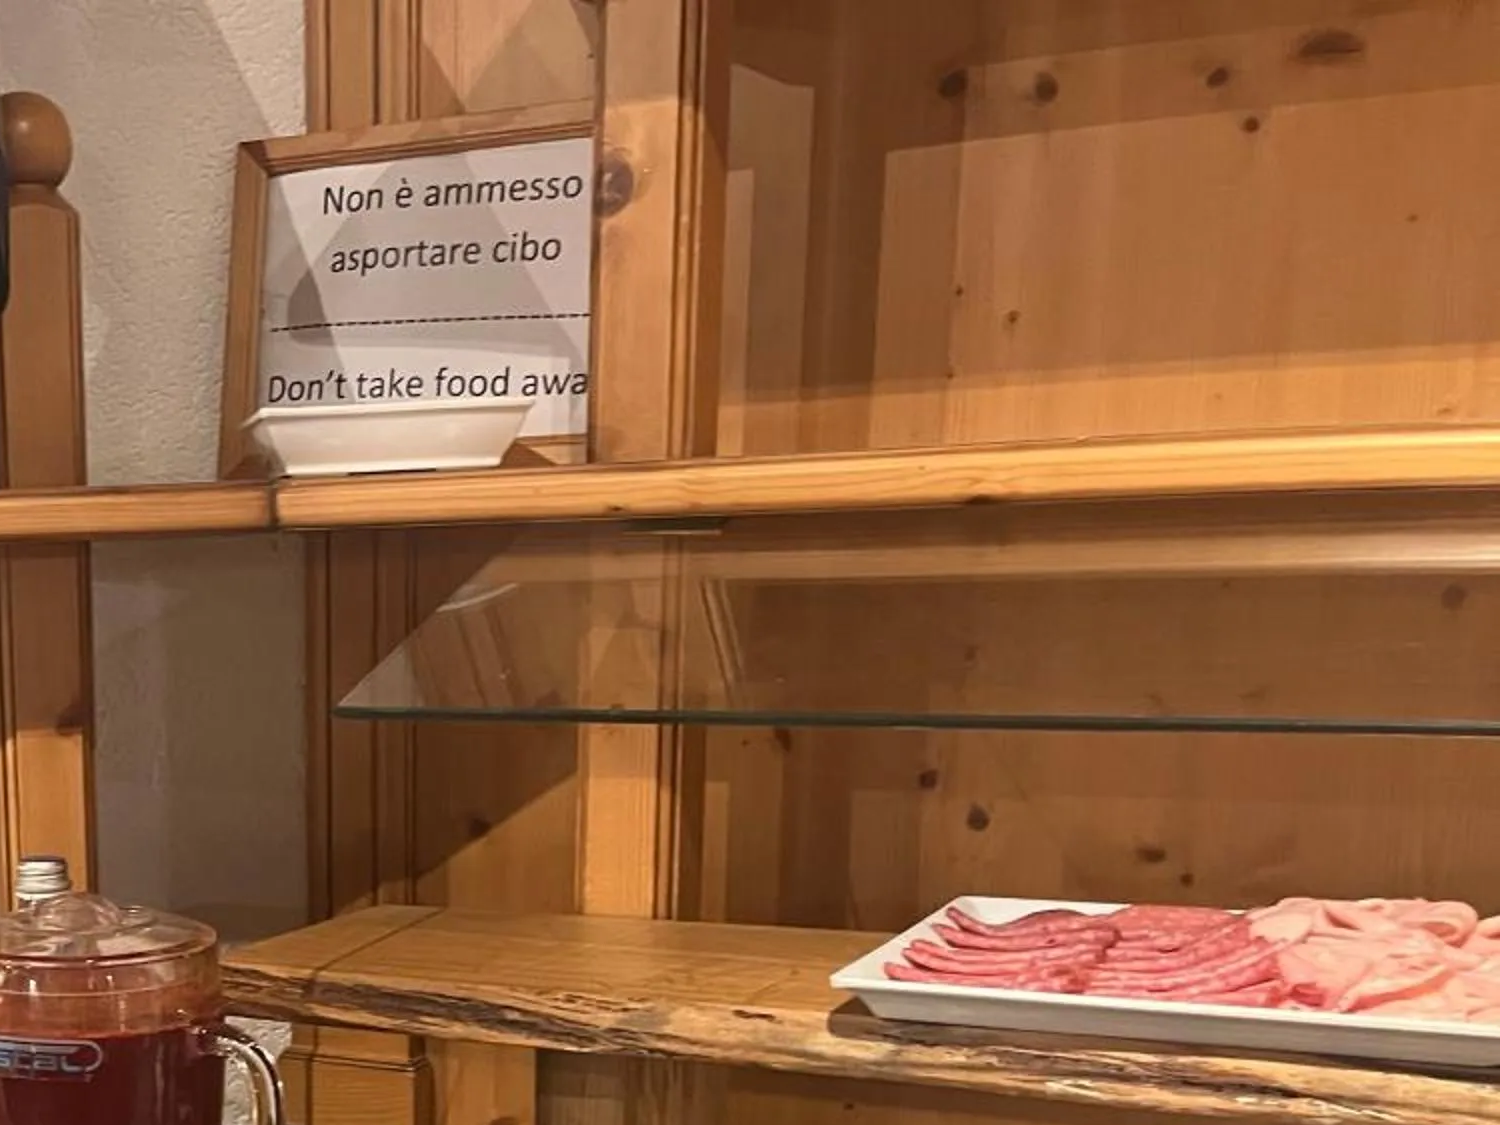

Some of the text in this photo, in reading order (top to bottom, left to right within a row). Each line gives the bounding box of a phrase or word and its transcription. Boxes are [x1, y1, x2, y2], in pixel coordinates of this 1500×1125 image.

[323, 175, 583, 216] Non è ammesso
[331, 231, 562, 277] asportare cibo
[356, 368, 424, 399] take
[435, 365, 511, 398] food
[520, 371, 589, 398] awa
